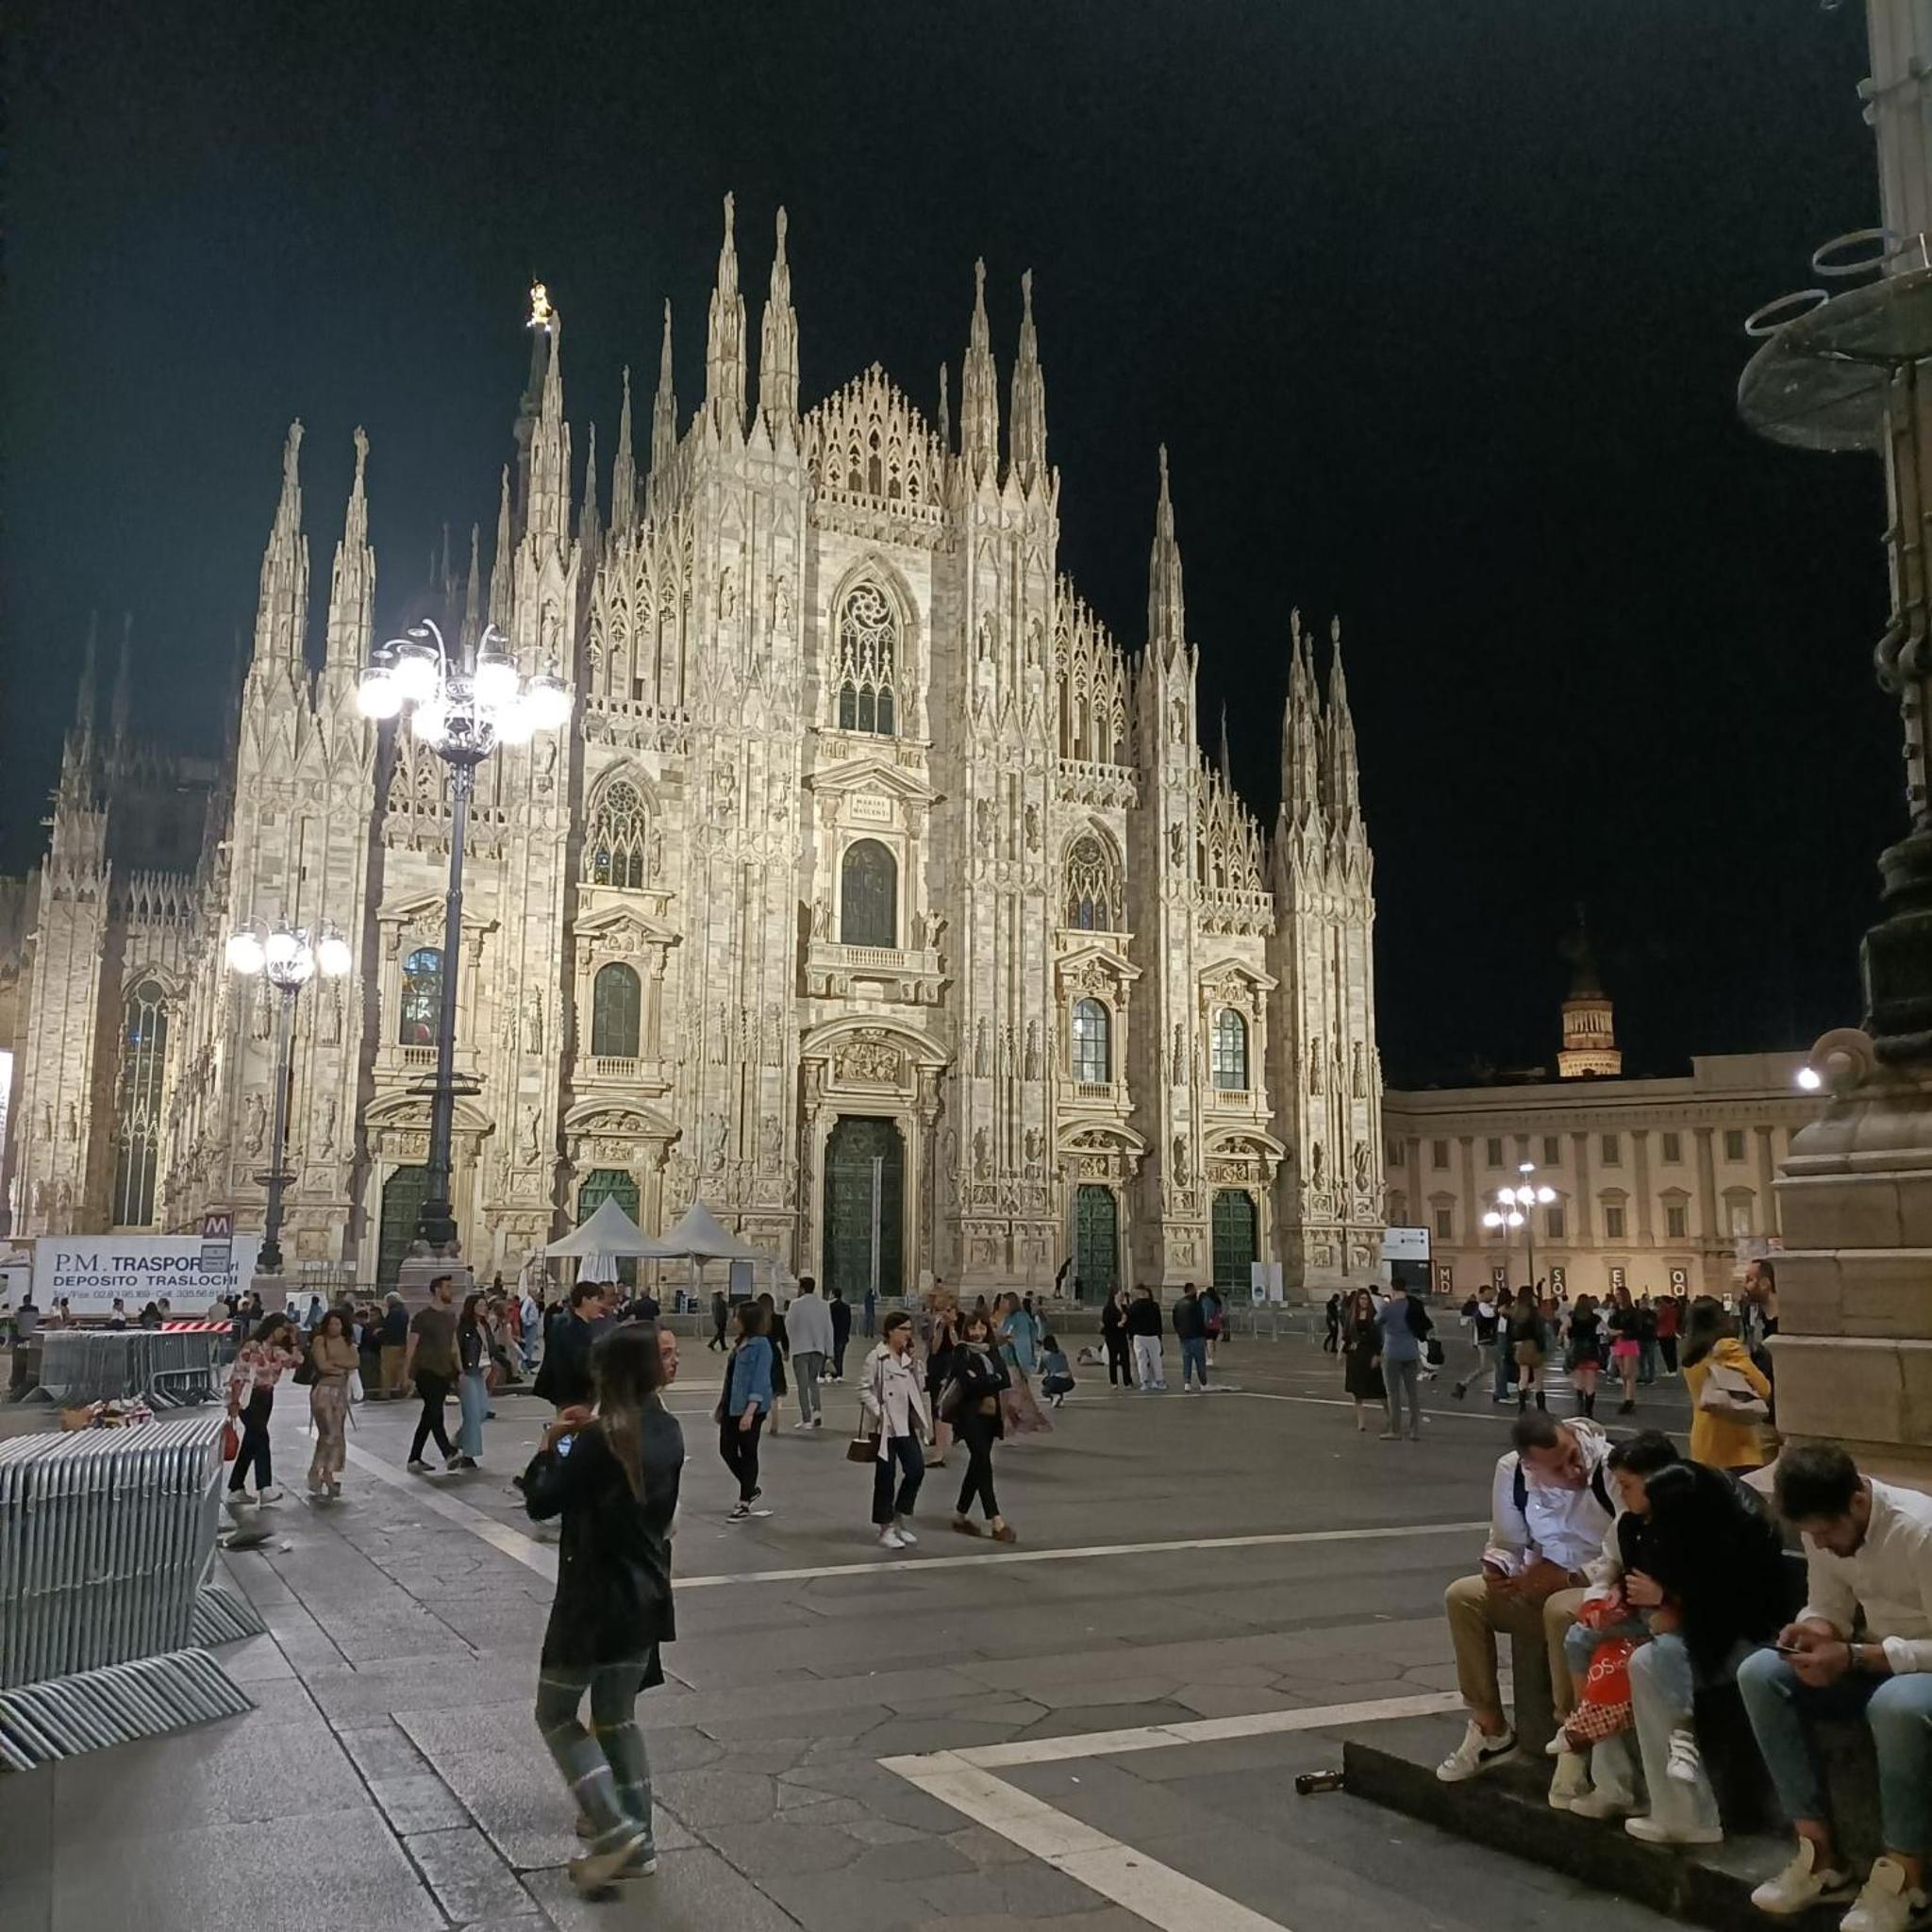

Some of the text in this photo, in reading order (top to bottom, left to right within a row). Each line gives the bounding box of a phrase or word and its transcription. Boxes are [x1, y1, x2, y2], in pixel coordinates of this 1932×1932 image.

[206, 1217, 227, 1233] M
[111, 1257, 202, 1272] TRASPOR
[54, 1275, 238, 1286] DEPOSITO TRASLOCHI
